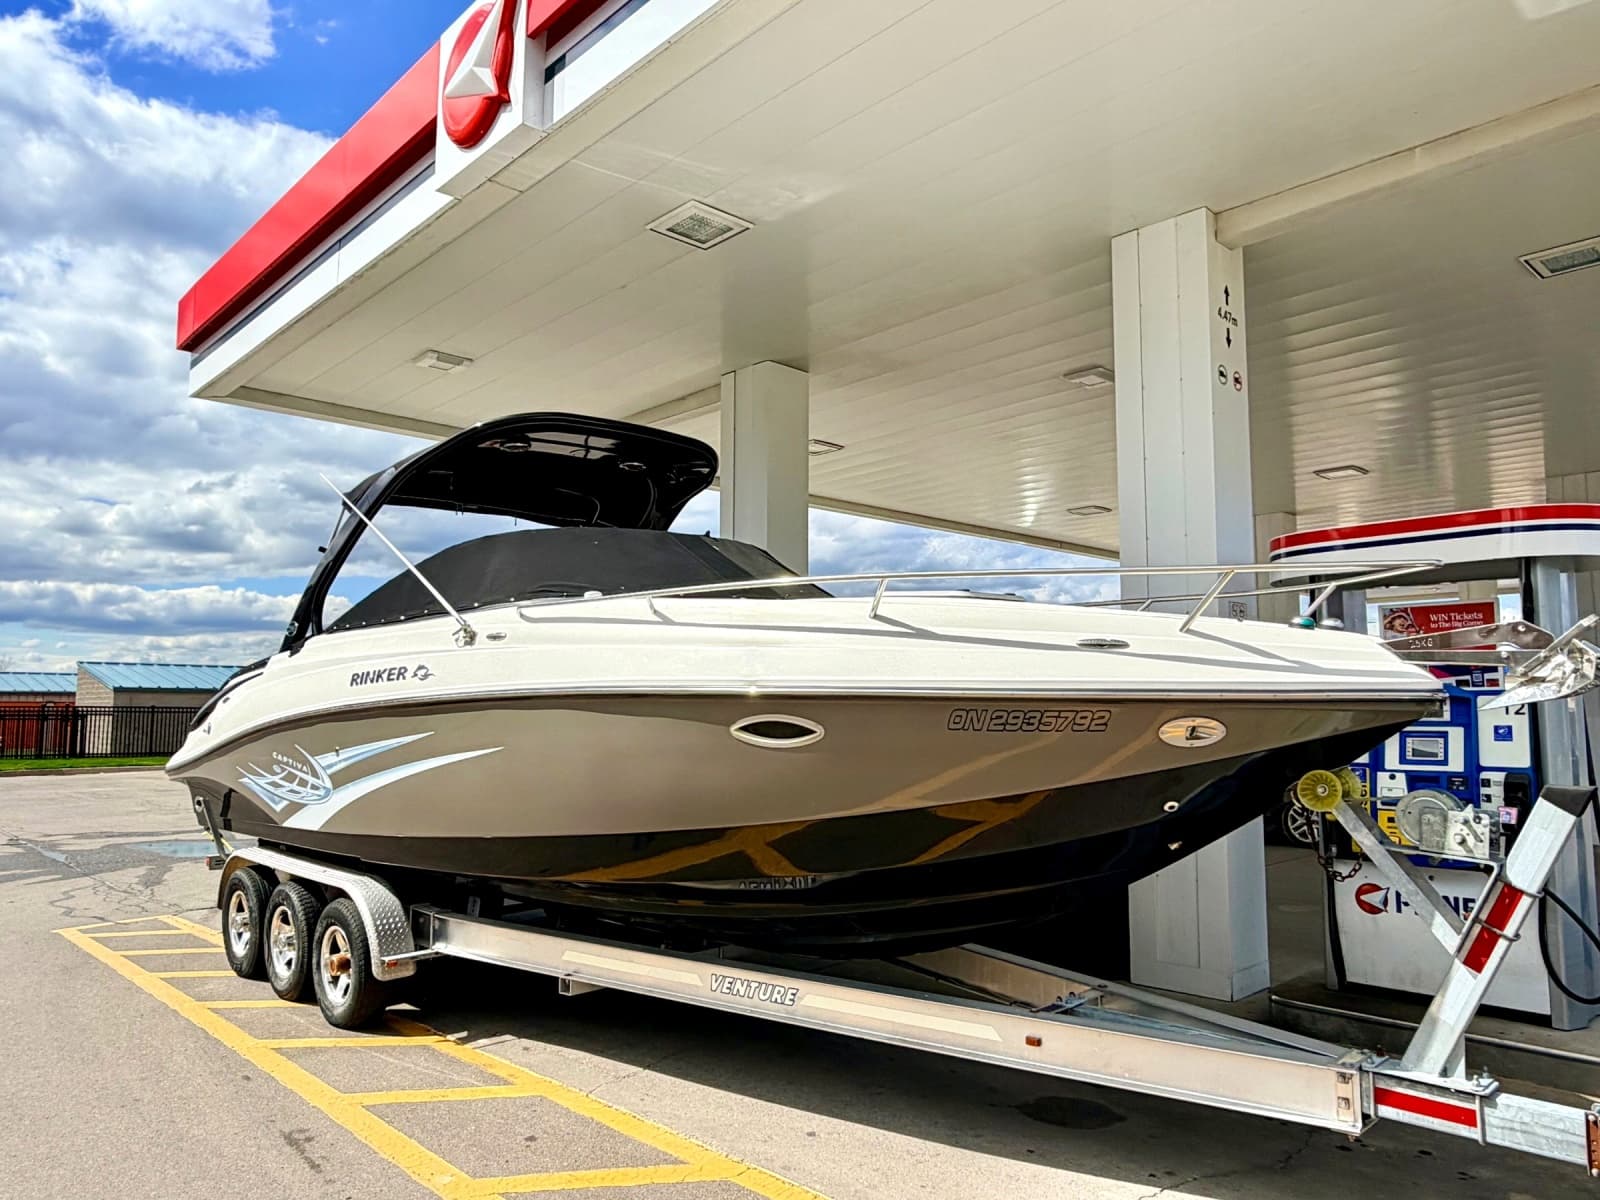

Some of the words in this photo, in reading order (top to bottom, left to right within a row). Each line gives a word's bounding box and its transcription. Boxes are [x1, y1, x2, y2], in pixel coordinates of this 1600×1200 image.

[1217, 306, 1238, 327] 4.47m
[1429, 612, 1448, 621] WIN
[1449, 611, 1483, 620] Tickets
[349, 666, 408, 687] RINKER
[947, 708, 988, 731] ON
[987, 709, 1112, 732] 2935792
[272, 751, 308, 773] CAPTIVA
[710, 973, 800, 1007] VENTURE
